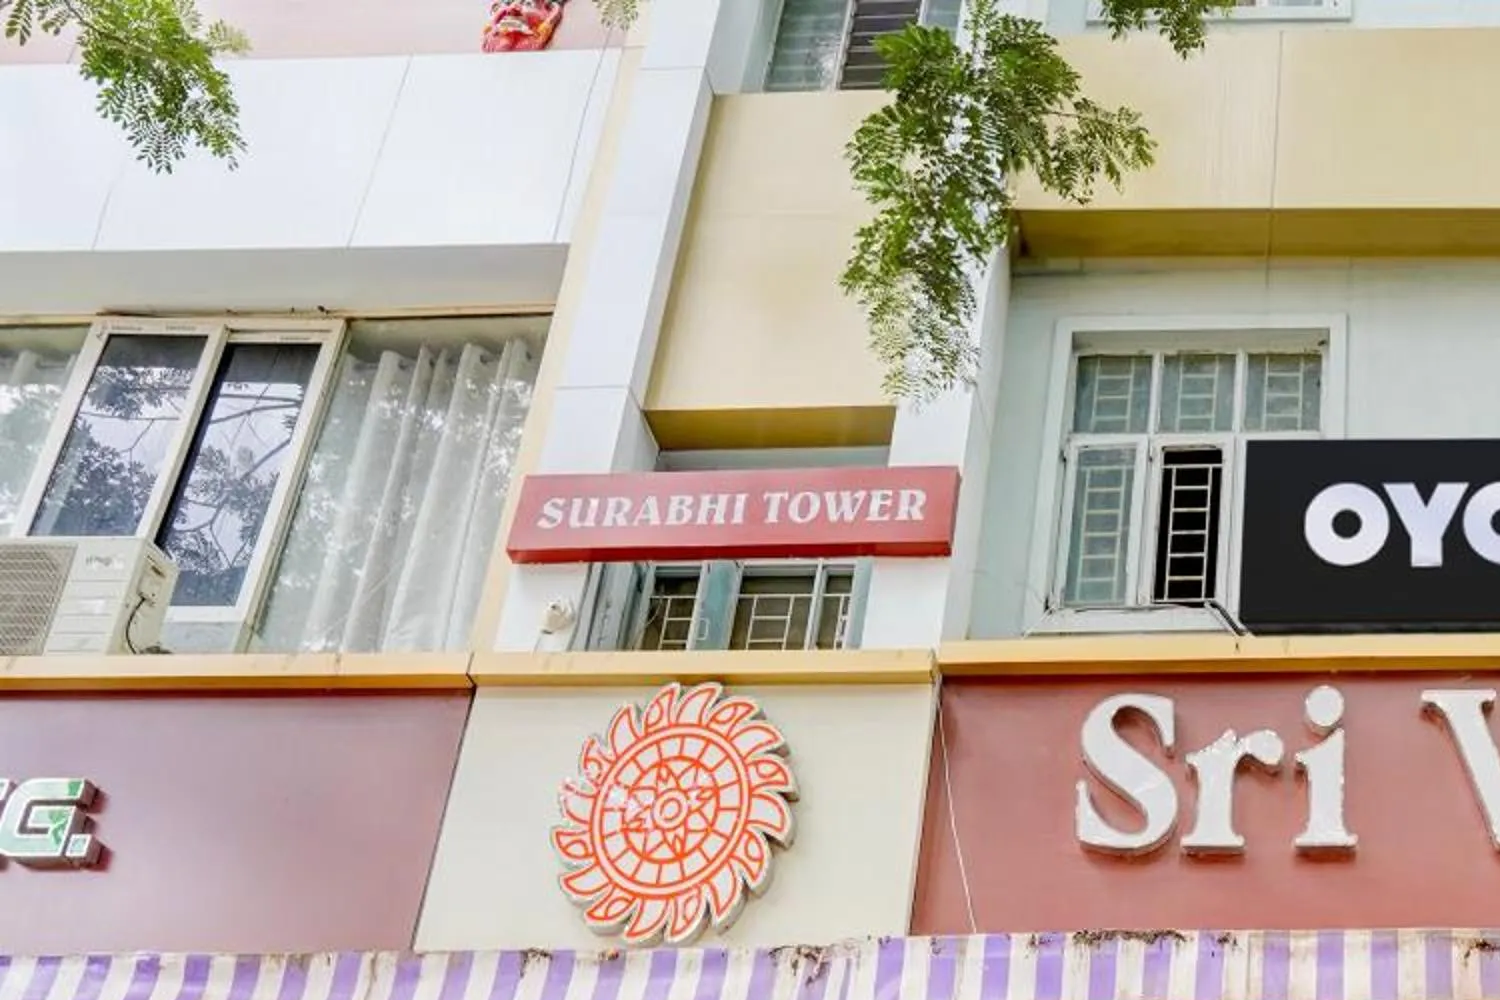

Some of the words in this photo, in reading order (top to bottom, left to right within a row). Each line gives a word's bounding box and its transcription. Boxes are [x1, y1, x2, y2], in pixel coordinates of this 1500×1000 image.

[536, 492, 750, 530] SURABHI
[762, 488, 928, 524] TOWER
[1076, 683, 1359, 853] Sri
